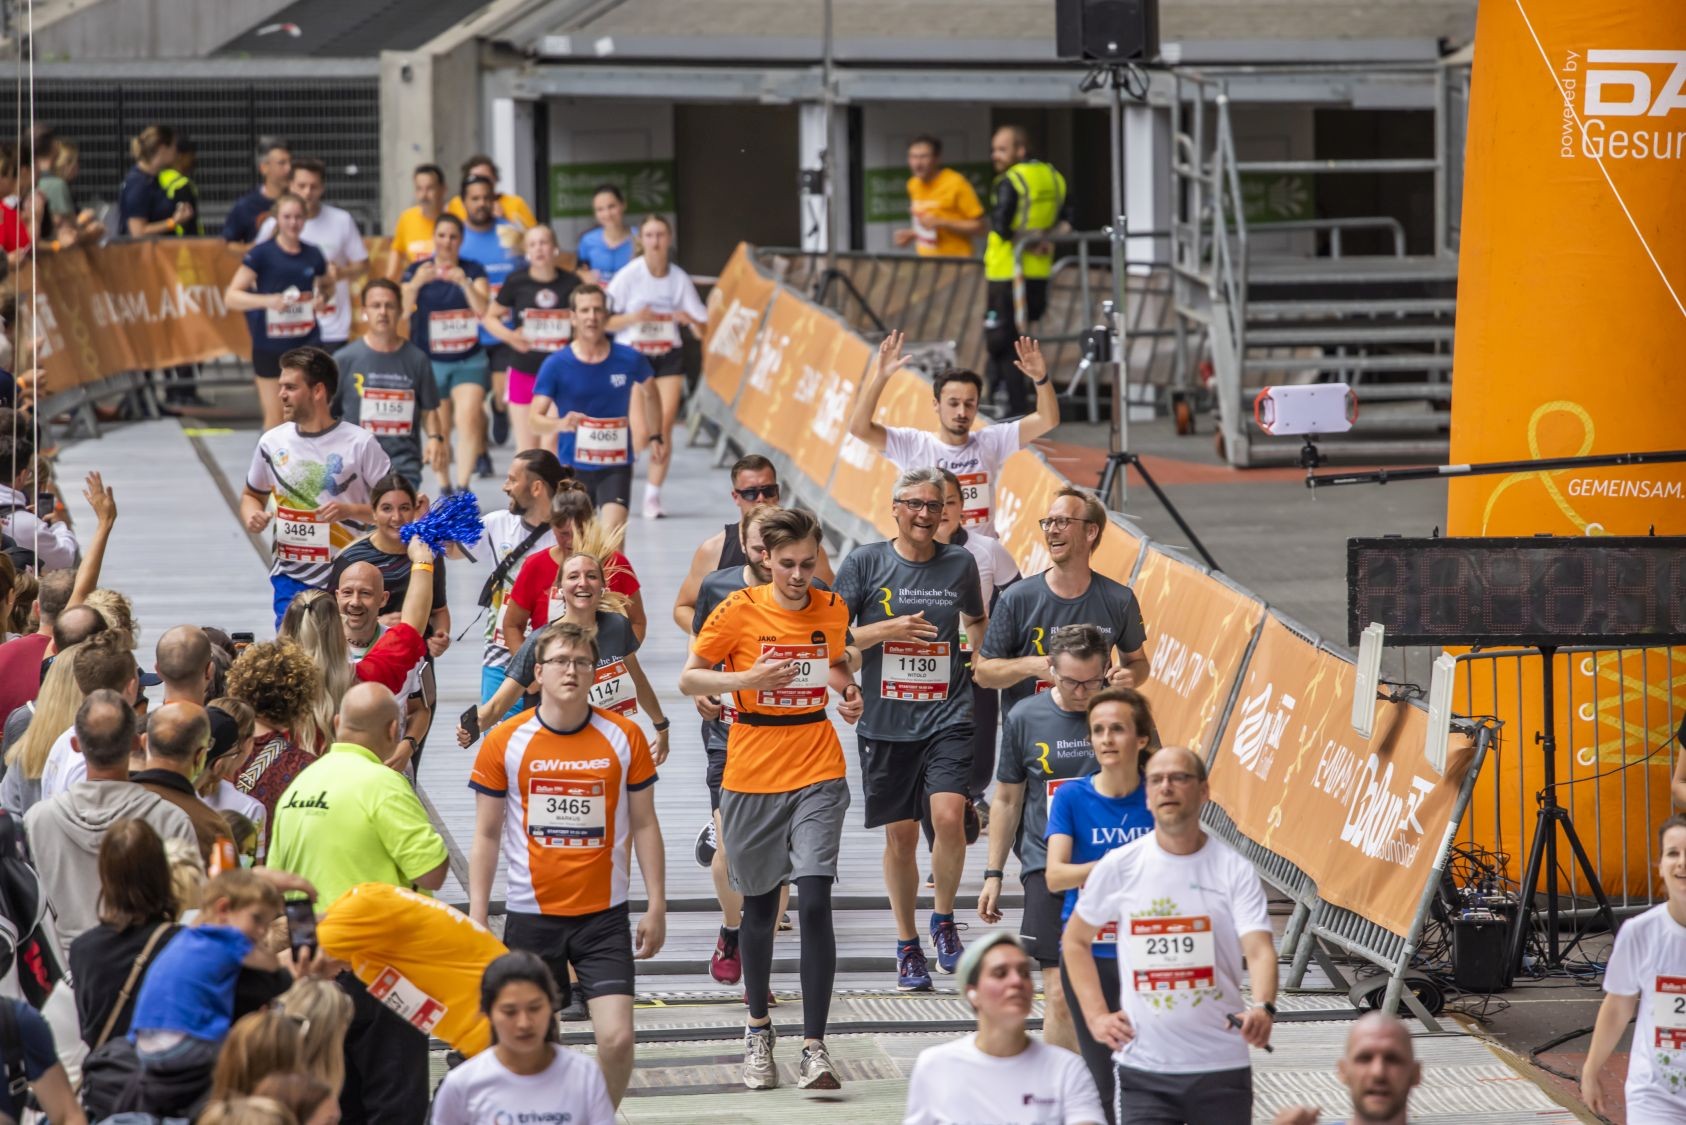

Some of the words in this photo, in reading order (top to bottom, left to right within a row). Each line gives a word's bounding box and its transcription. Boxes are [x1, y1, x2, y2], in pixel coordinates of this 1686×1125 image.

[1562, 50, 1581, 72] by
[1561, 79, 1577, 158] powered
[376, 402, 404, 413] 1155
[590, 430, 618, 441] 4065
[1568, 478, 1686, 499] GEMEINSAM.
[284, 522, 315, 537] 3484
[898, 588, 942, 597] Rheinische
[944, 590, 958, 598] Post
[898, 597, 953, 606] Mediengruppe
[899, 657, 937, 672] 1130
[589, 679, 620, 702] 1147
[546, 797, 591, 815] 3465
[1091, 827, 1151, 845] LVMH
[1146, 936, 1194, 955] 2319
